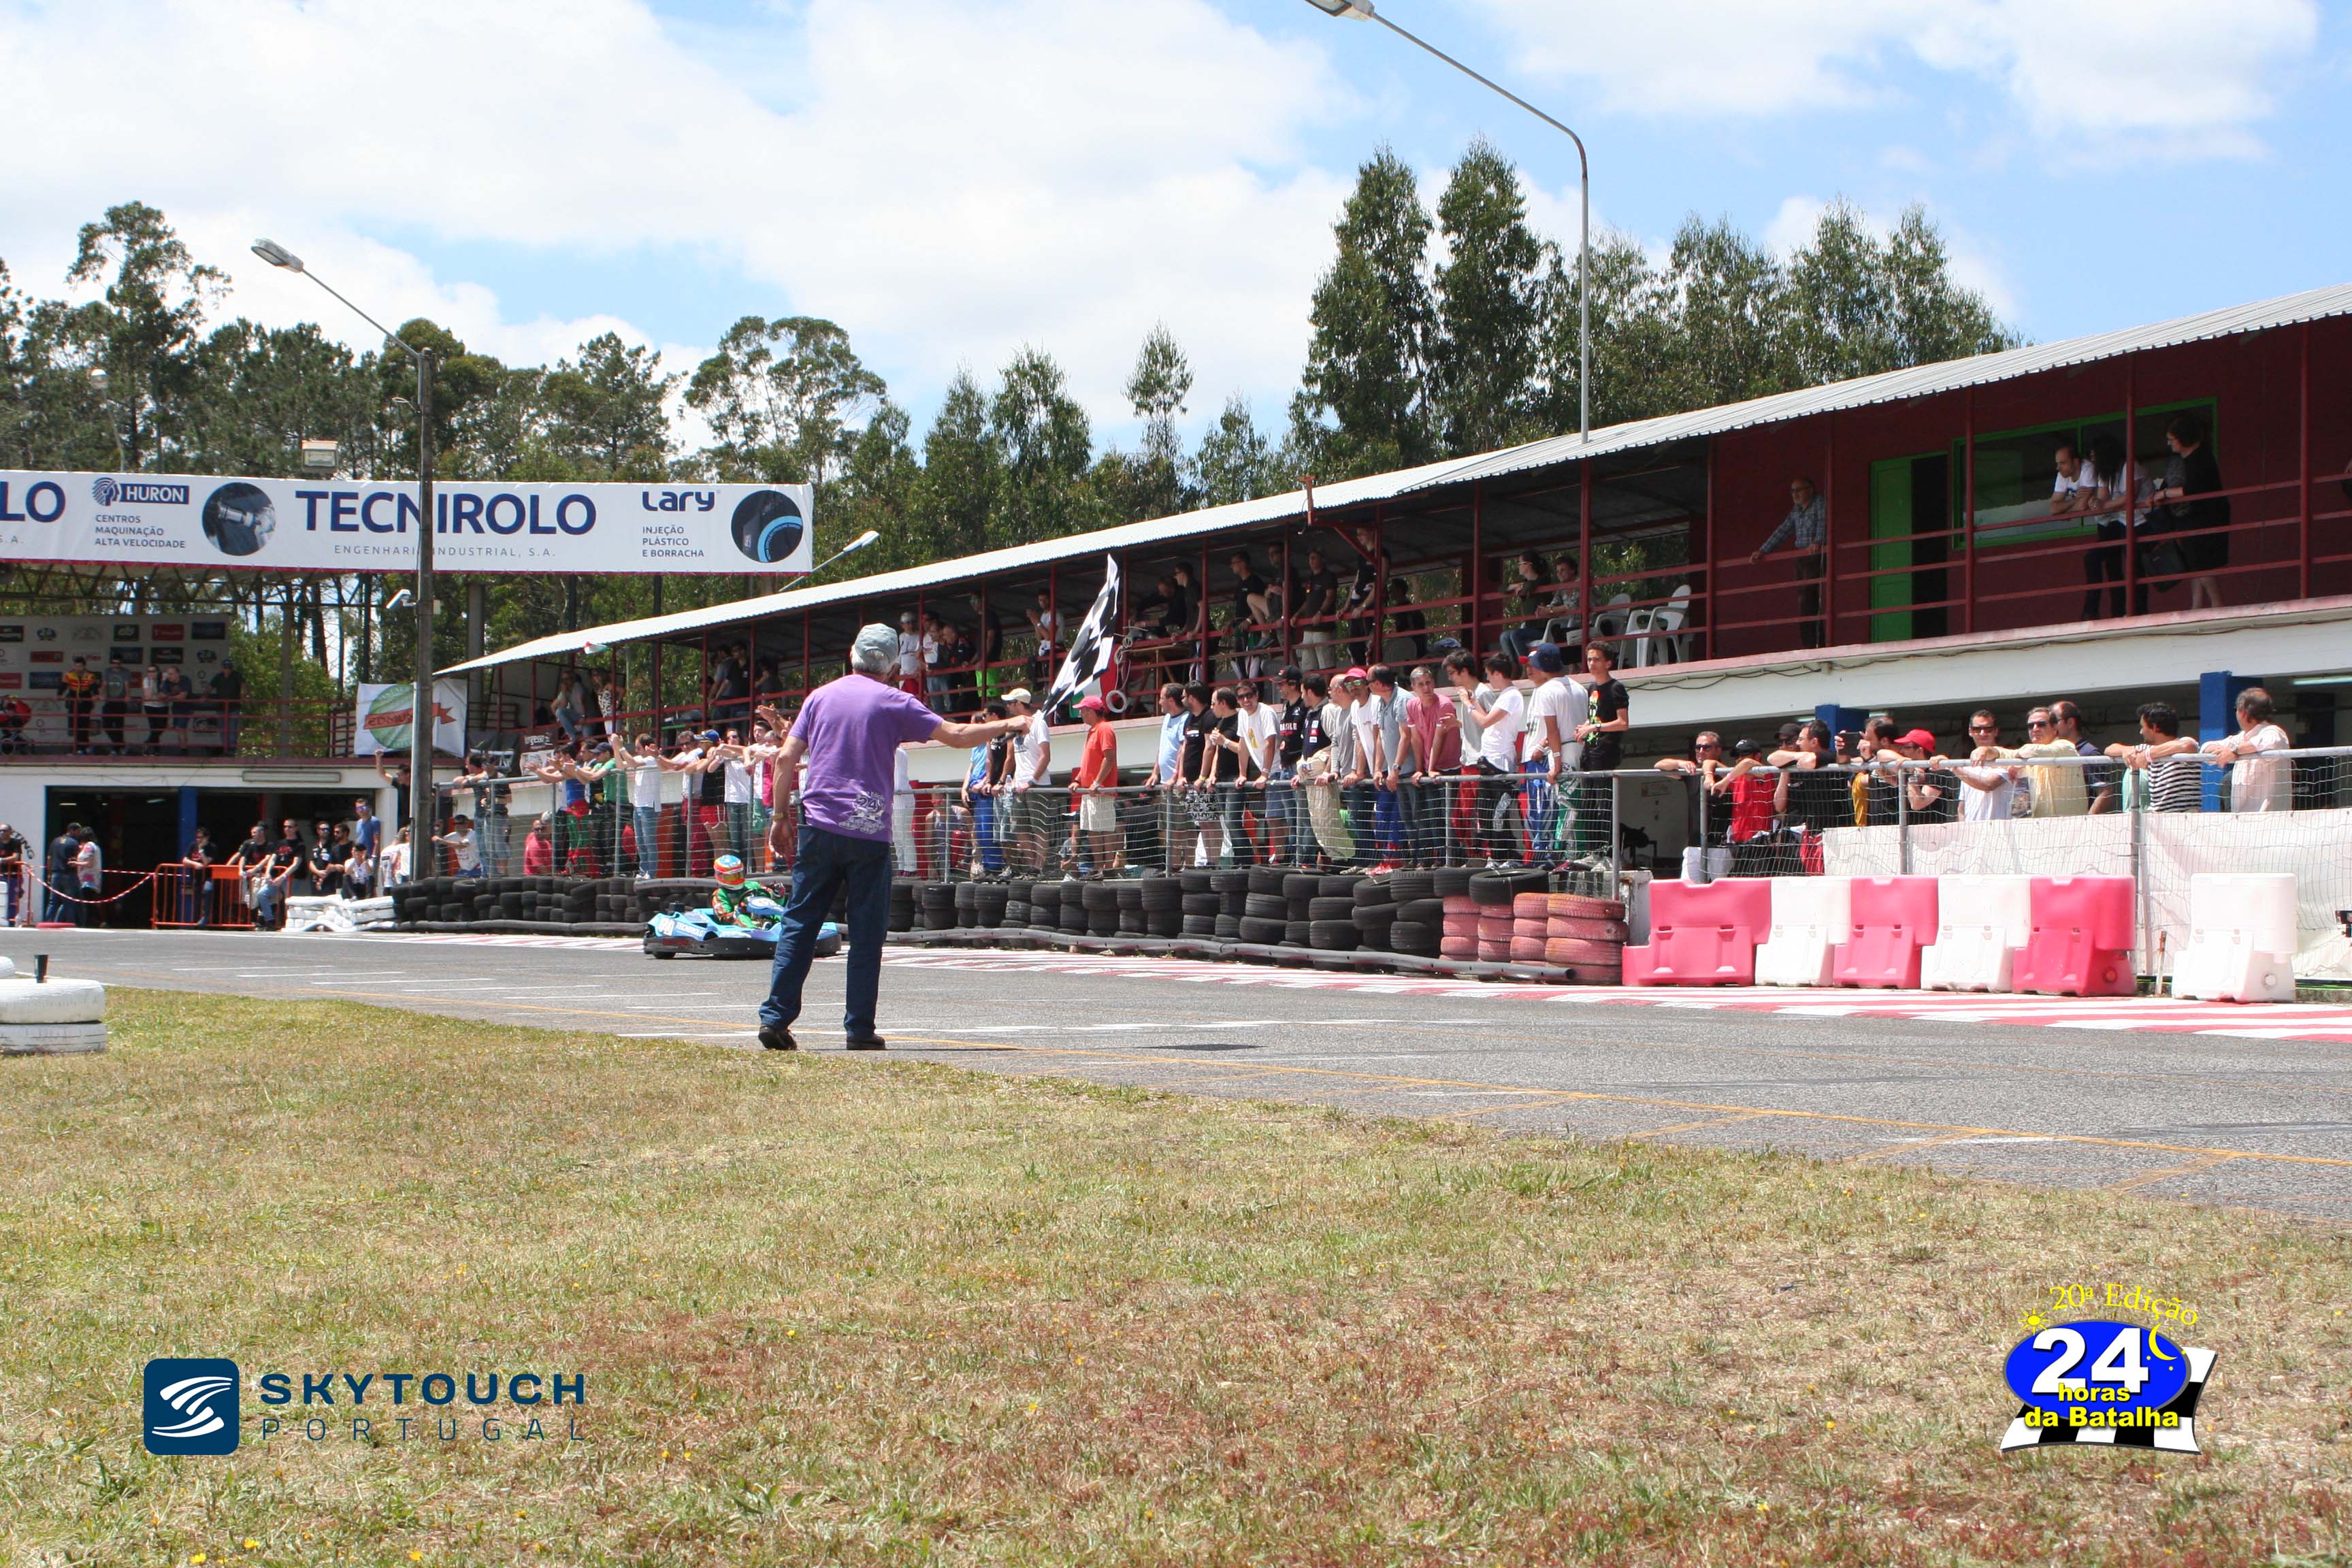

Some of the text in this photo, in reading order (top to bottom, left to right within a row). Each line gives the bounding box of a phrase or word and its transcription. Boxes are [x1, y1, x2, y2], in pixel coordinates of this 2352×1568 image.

[126, 486, 184, 502] HURON
[95, 514, 141, 523] CENTROS
[295, 490, 597, 536] TECNIROLO
[95, 525, 164, 537] MAQUINAÇÃO
[642, 525, 685, 536] INJEÇÃO
[95, 538, 186, 549] ALTA VELOCIDADE
[642, 536, 689, 546] PLÁSTICO
[334, 545, 416, 555] ENGENHARI
[528, 547, 556, 557] S.A.
[642, 549, 705, 557] E BORRACHA
